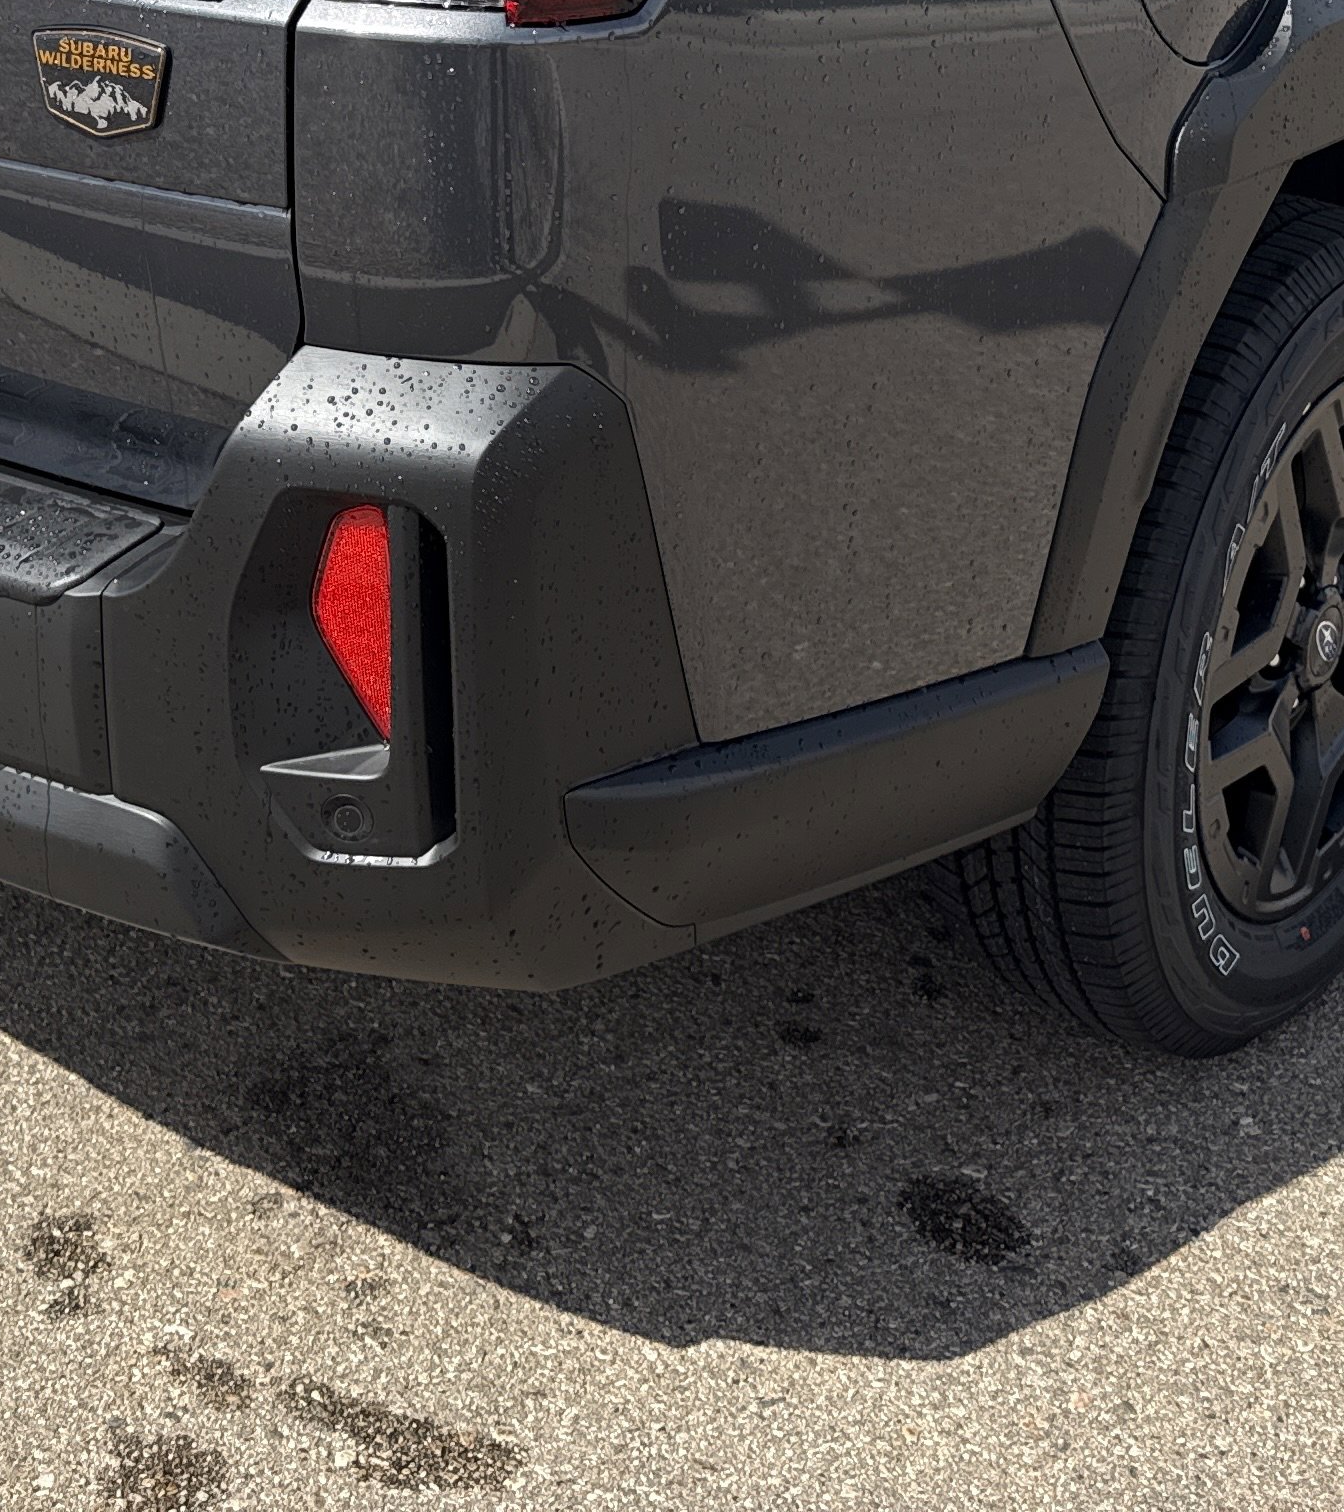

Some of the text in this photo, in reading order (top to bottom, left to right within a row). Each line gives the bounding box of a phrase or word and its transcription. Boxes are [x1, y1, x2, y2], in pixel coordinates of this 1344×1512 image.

[38, 49, 156, 80] WILDERNESS
[58, 38, 133, 63] SUBARU
[1182, 631, 1241, 977] DUELER
